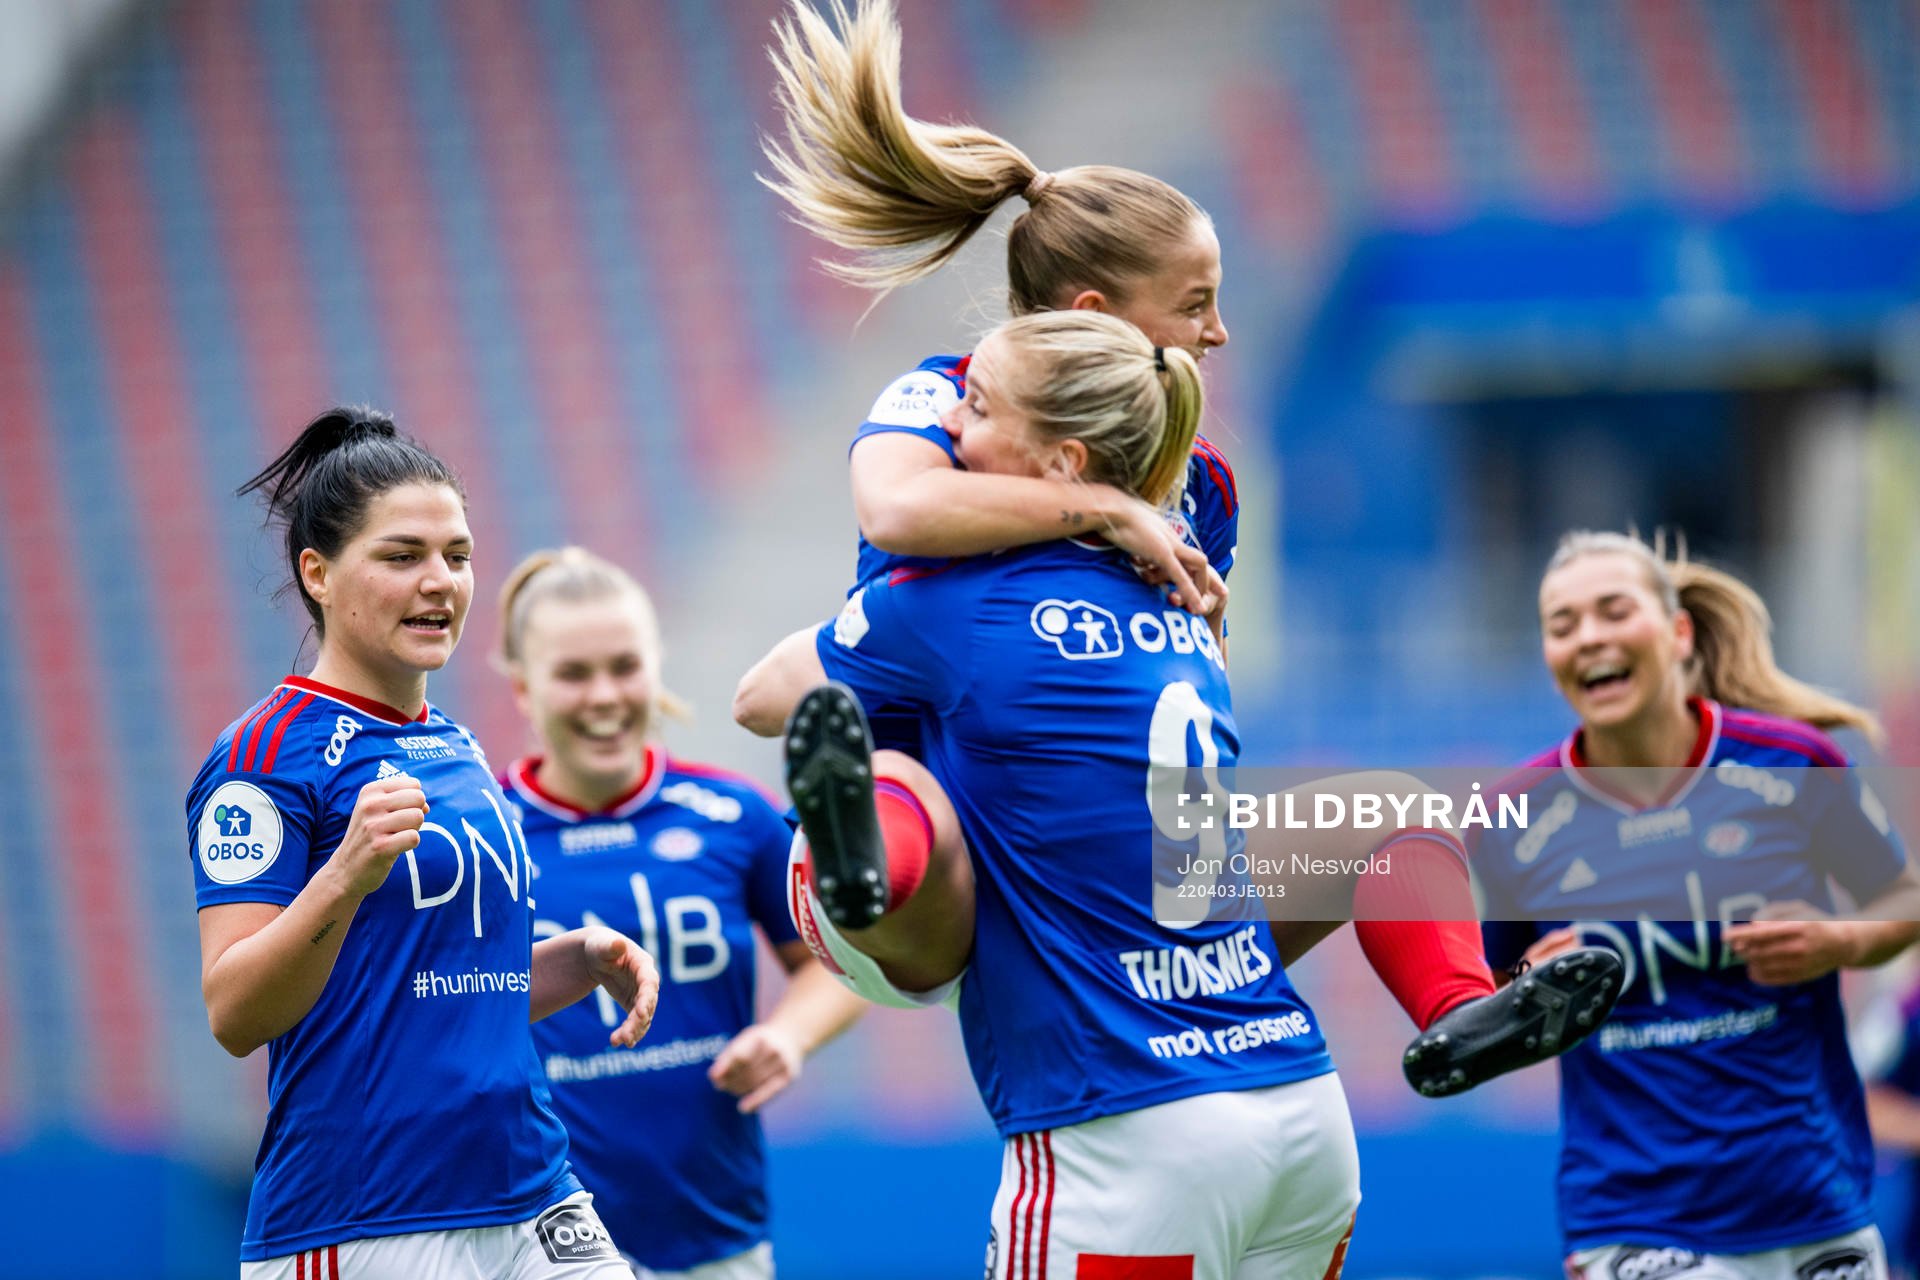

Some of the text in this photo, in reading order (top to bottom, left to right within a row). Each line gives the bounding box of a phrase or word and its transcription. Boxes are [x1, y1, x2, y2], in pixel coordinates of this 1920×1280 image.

[406, 747, 457, 760] RECYCLING
[1146, 680, 1228, 930] 9
[207, 842, 264, 861] OBOS
[1147, 1010, 1311, 1059] mot rasisme
